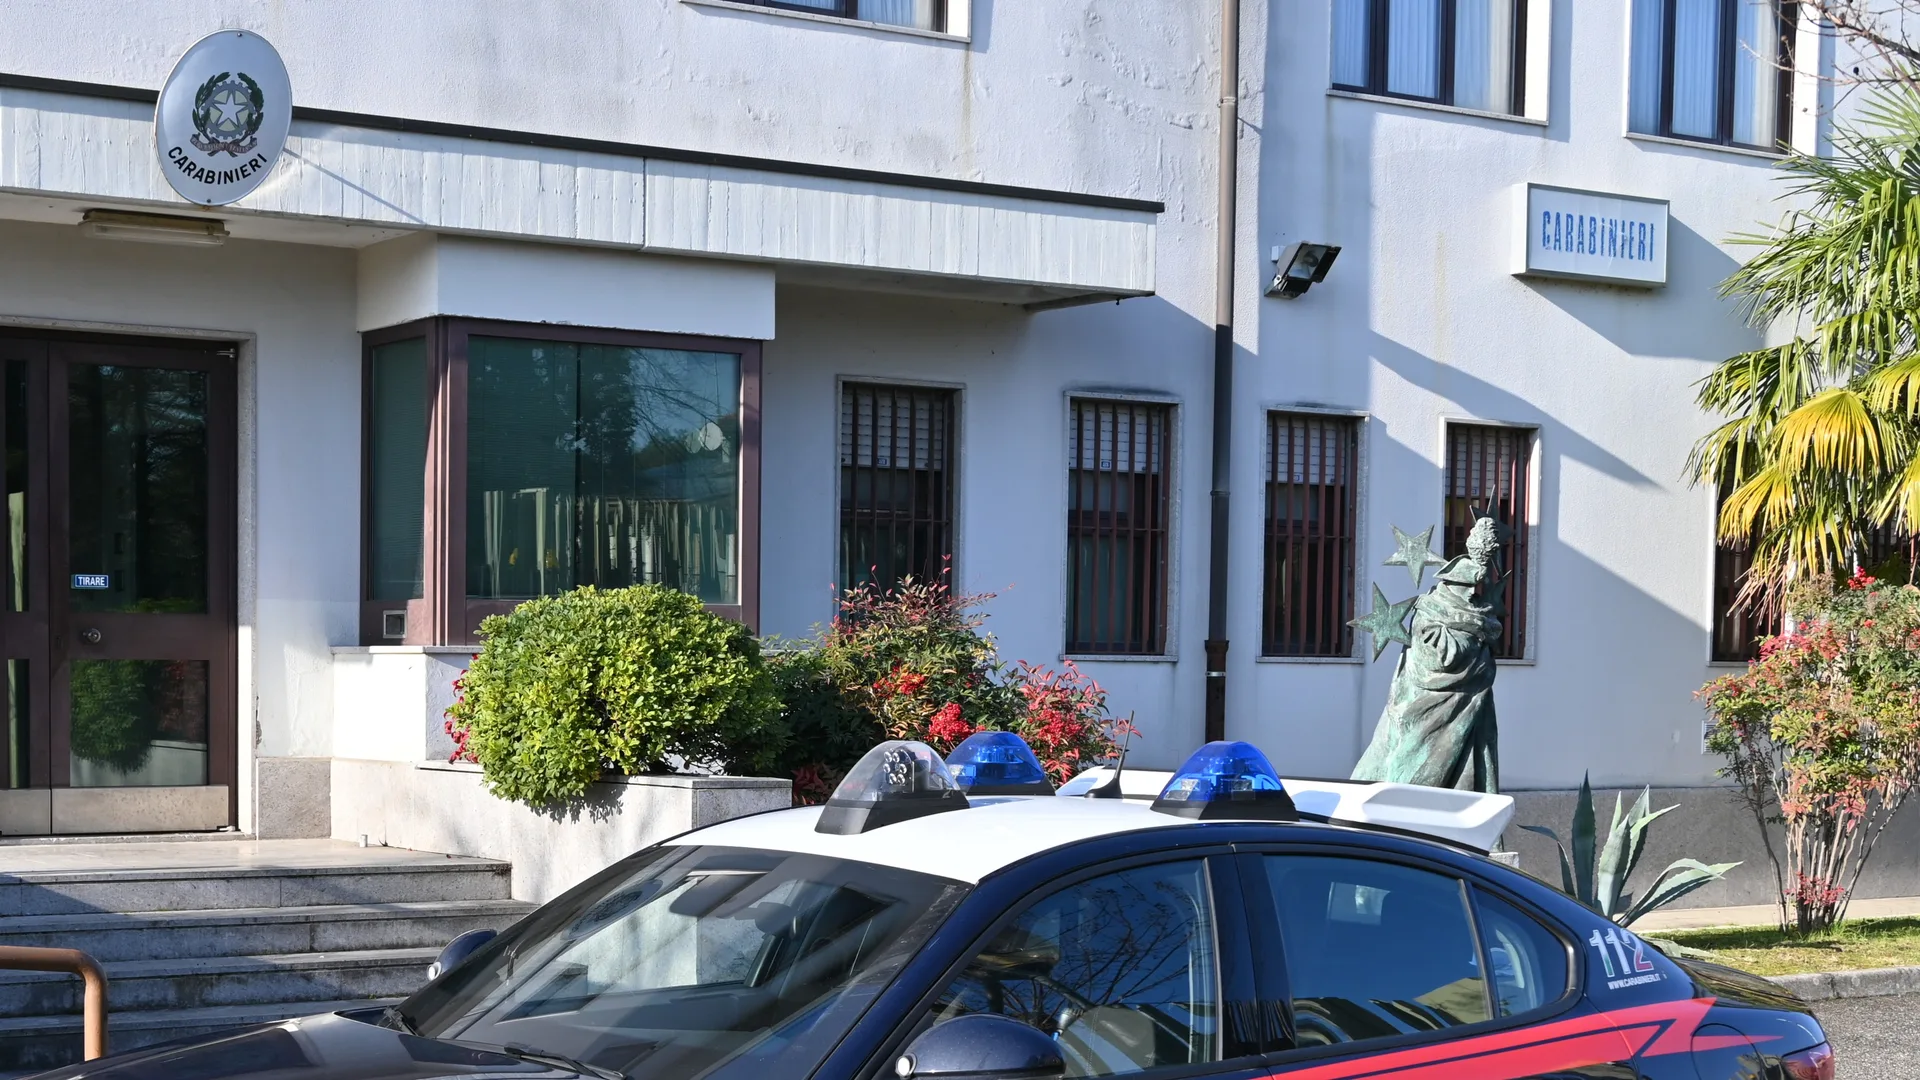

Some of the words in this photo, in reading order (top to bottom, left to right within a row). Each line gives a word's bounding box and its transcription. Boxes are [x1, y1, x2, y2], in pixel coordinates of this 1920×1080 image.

[168, 146, 267, 185] CARABINIERI
[1542, 210, 1654, 262] CARABINIERI
[77, 576, 105, 586] TIRARE
[1589, 928, 1654, 977] 112
